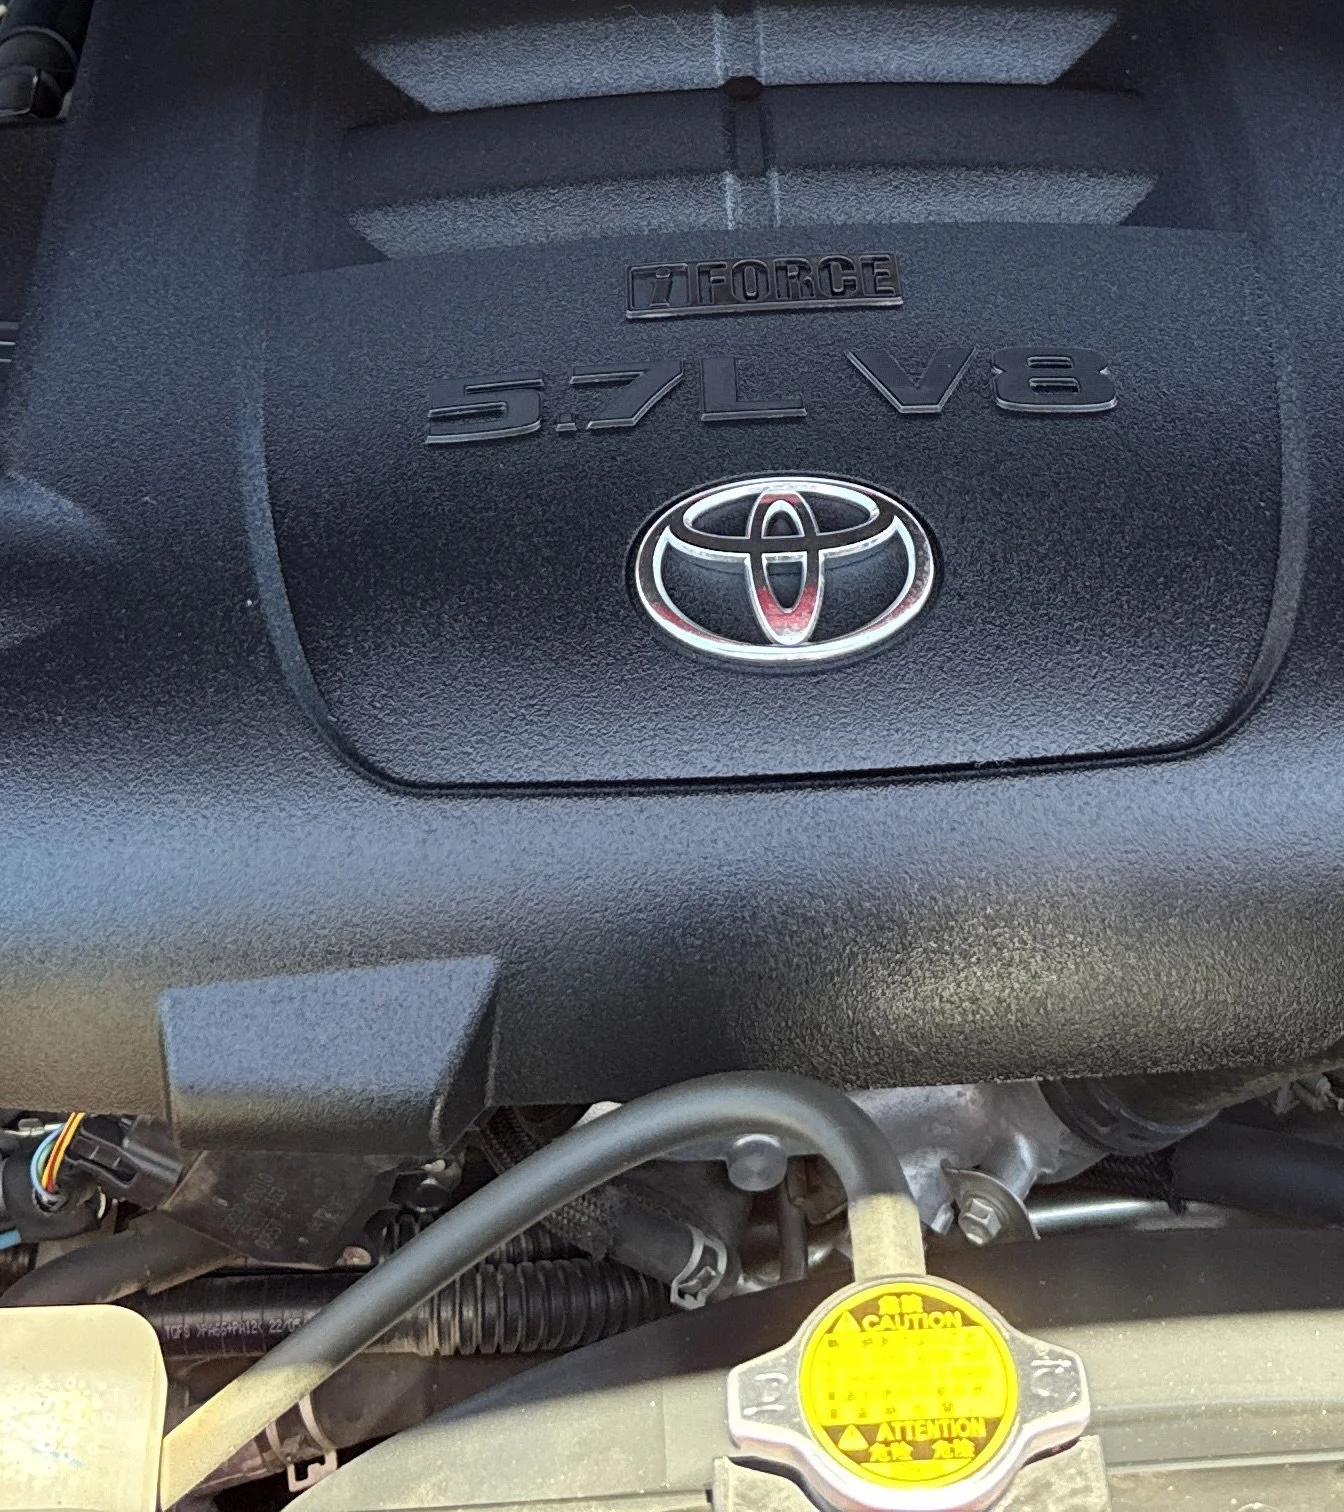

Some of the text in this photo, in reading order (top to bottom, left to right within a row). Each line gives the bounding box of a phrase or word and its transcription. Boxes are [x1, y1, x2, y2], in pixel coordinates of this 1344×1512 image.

[425, 346, 1119, 446] 5.7L V8
[861, 1311, 962, 1332] CAUTION
[876, 1417, 987, 1441] ATTENTION
